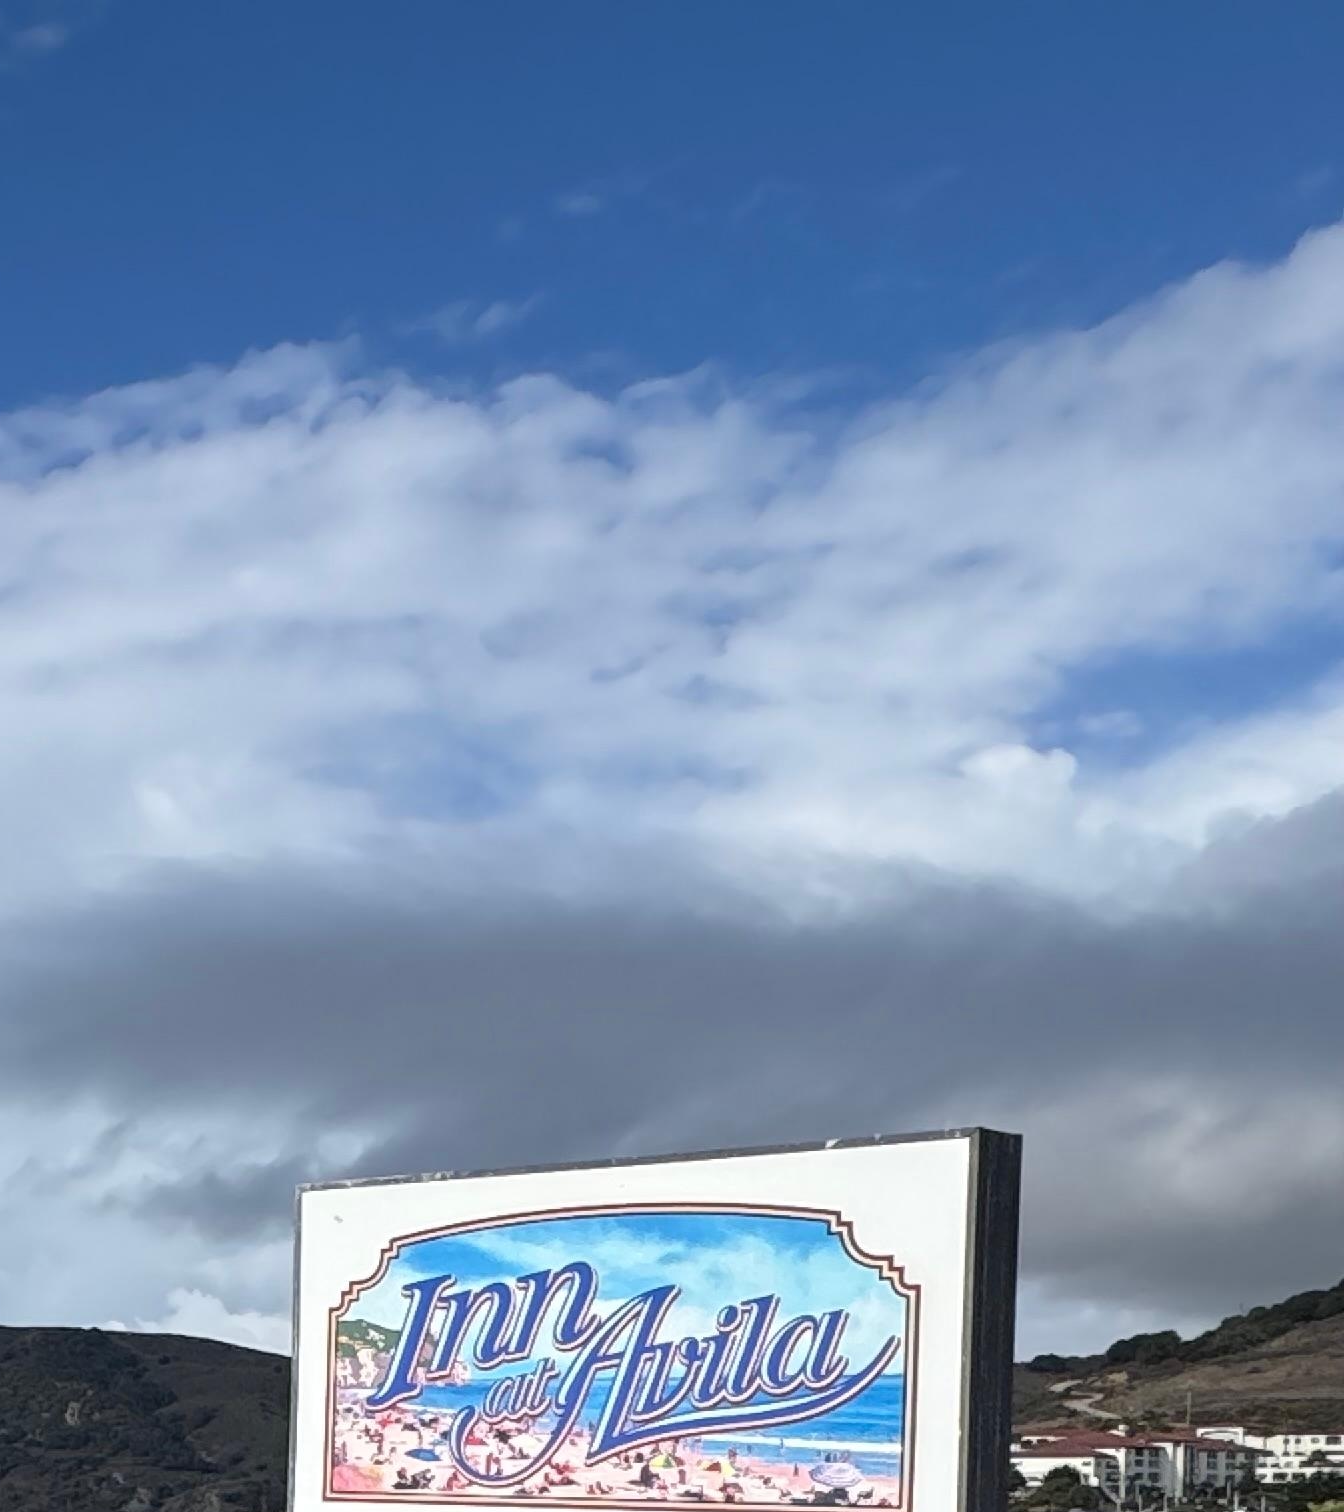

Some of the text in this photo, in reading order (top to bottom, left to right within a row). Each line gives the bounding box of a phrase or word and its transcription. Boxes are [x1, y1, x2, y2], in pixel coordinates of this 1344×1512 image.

[366, 1261, 902, 1487] Inn at Avila
